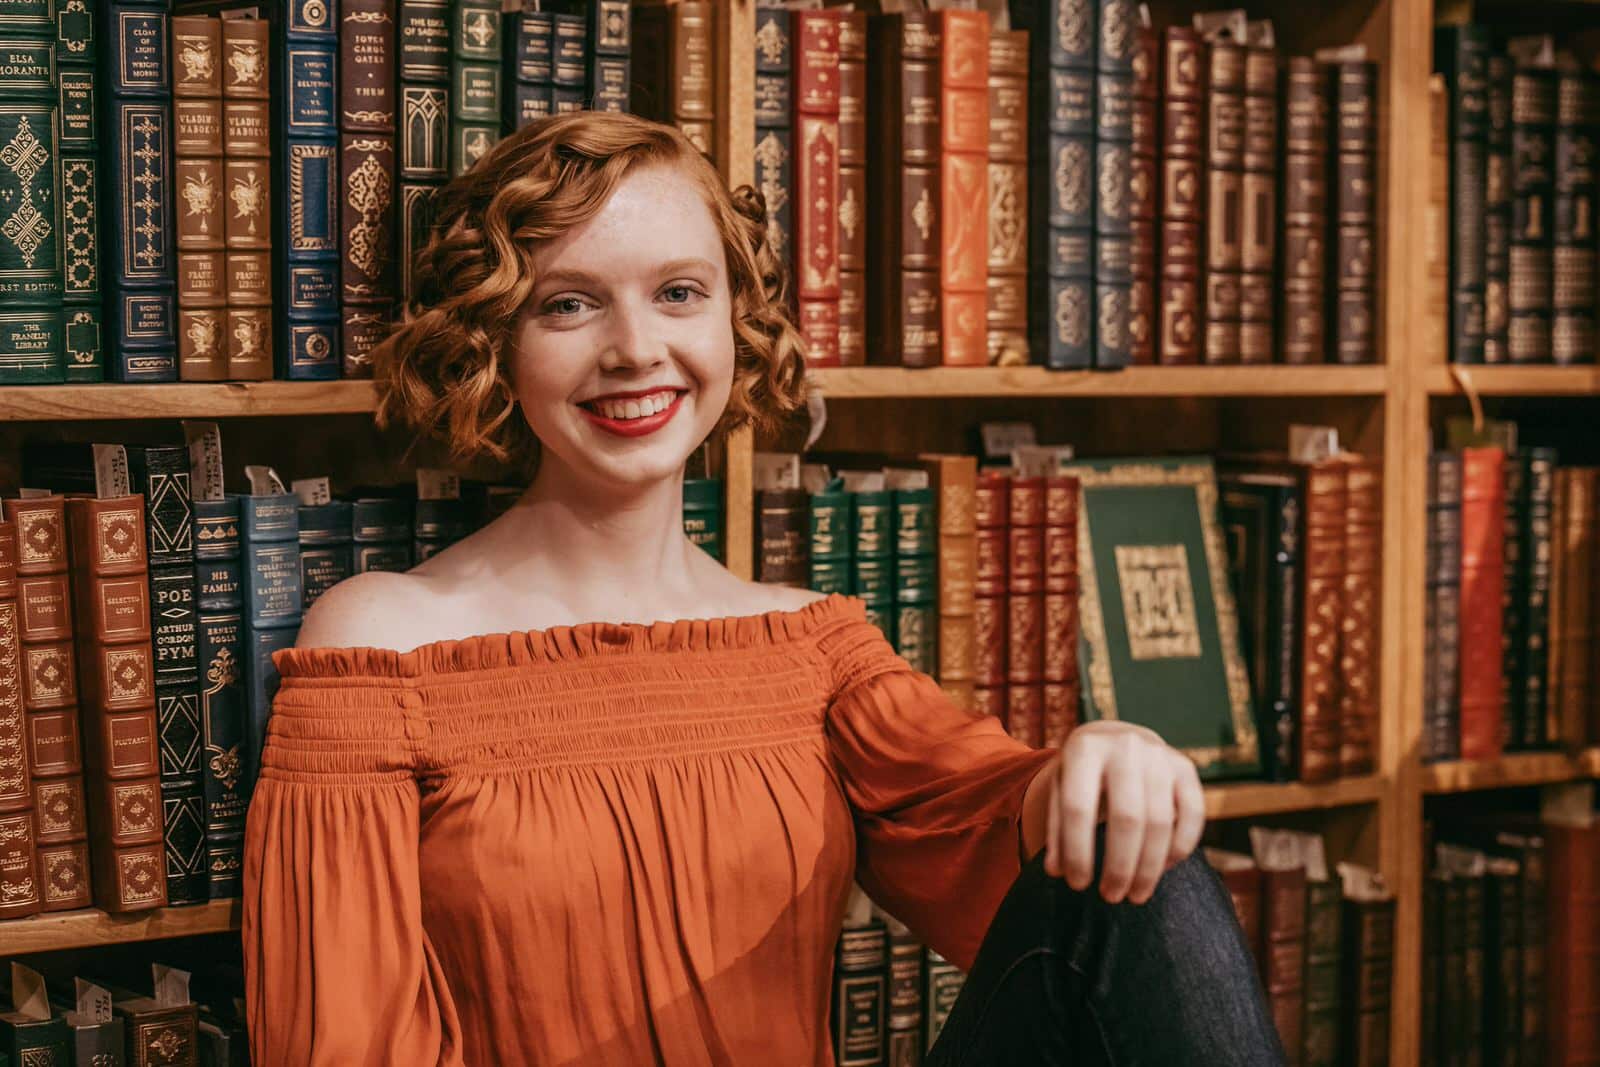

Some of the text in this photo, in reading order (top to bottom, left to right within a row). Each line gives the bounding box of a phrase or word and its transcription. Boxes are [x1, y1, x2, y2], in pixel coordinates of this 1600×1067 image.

[9, 54, 35, 63] ELSA
[354, 87, 385, 96] THEM
[180, 115, 212, 124] VLADIM
[11, 332, 51, 341] FRANKLIN
[211, 571, 228, 581] HIS
[202, 583, 239, 593] FAMILY
[158, 589, 193, 603] POE
[157, 623, 194, 634] ARTHUR
[157, 634, 194, 645] GORDON
[158, 645, 195, 660] PYM
